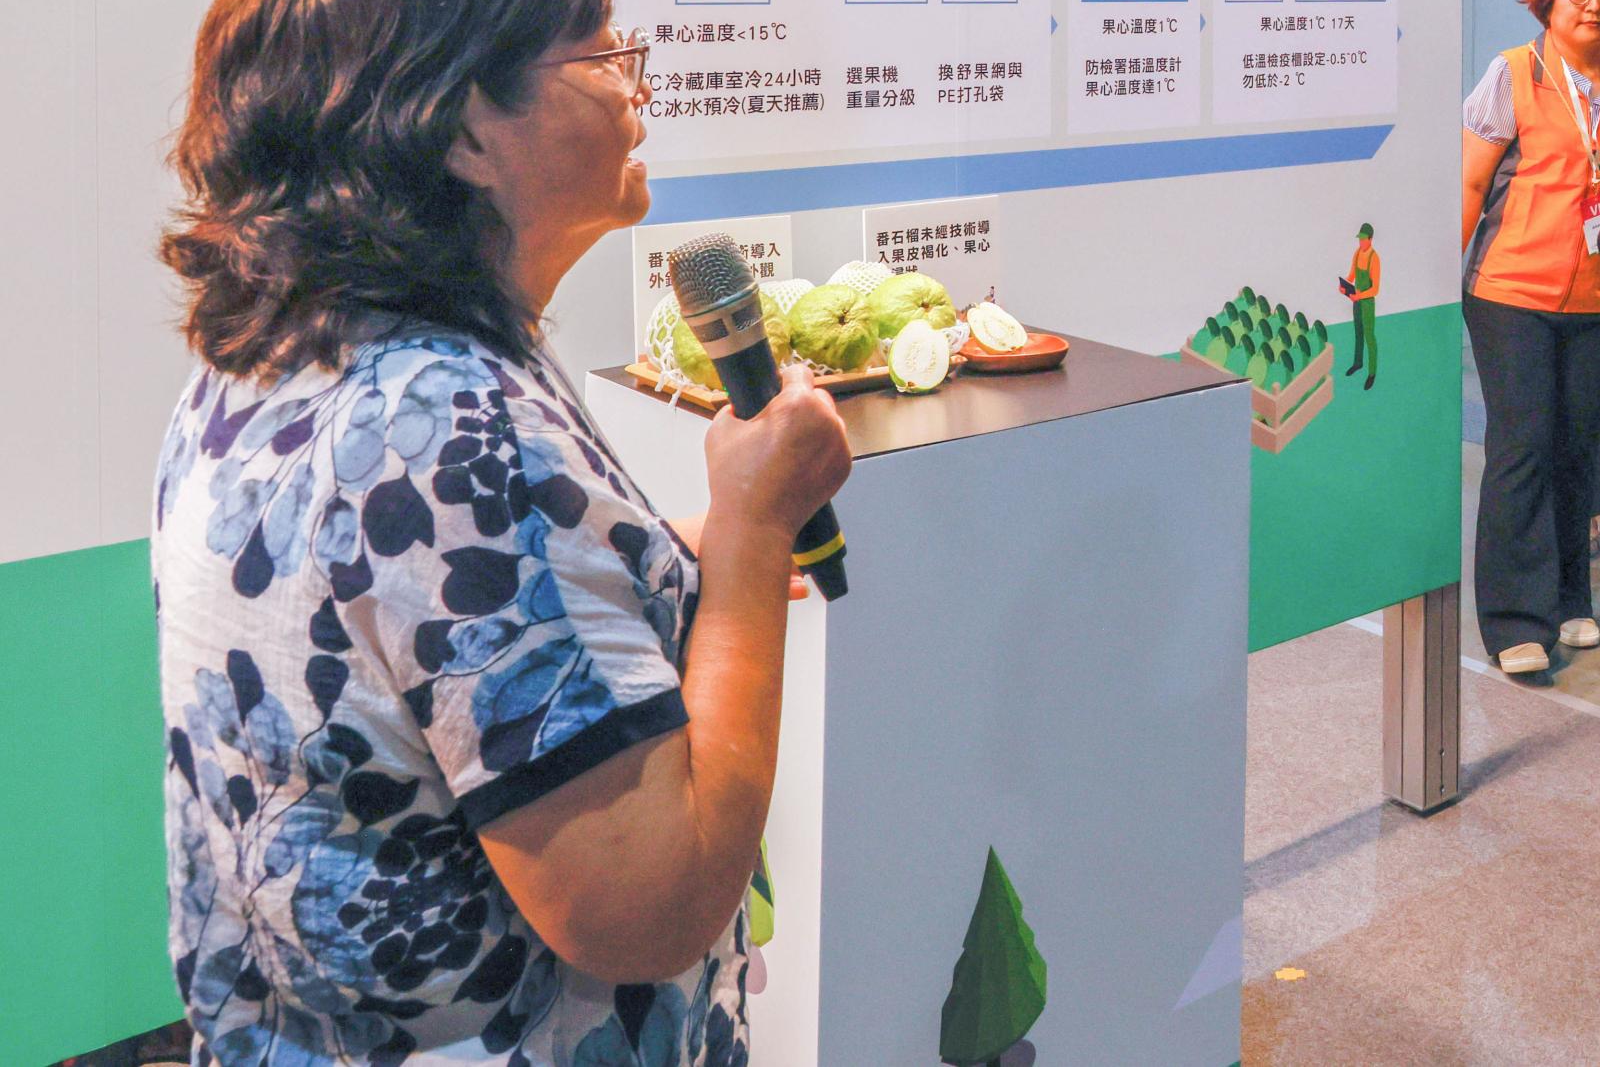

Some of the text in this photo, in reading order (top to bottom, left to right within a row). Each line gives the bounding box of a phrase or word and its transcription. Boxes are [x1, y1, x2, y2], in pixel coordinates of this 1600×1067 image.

[846, 65, 899, 85] 選果機
[937, 61, 1024, 82] 換舒果網與
[1084, 56, 1182, 75] 防檢署插溫度計
[846, 88, 916, 110] 重量分級
[937, 85, 1004, 104] PE打孔袋
[875, 220, 991, 248] 番石榴未經技術導
[878, 238, 991, 265] 入果皮褐化、果心
